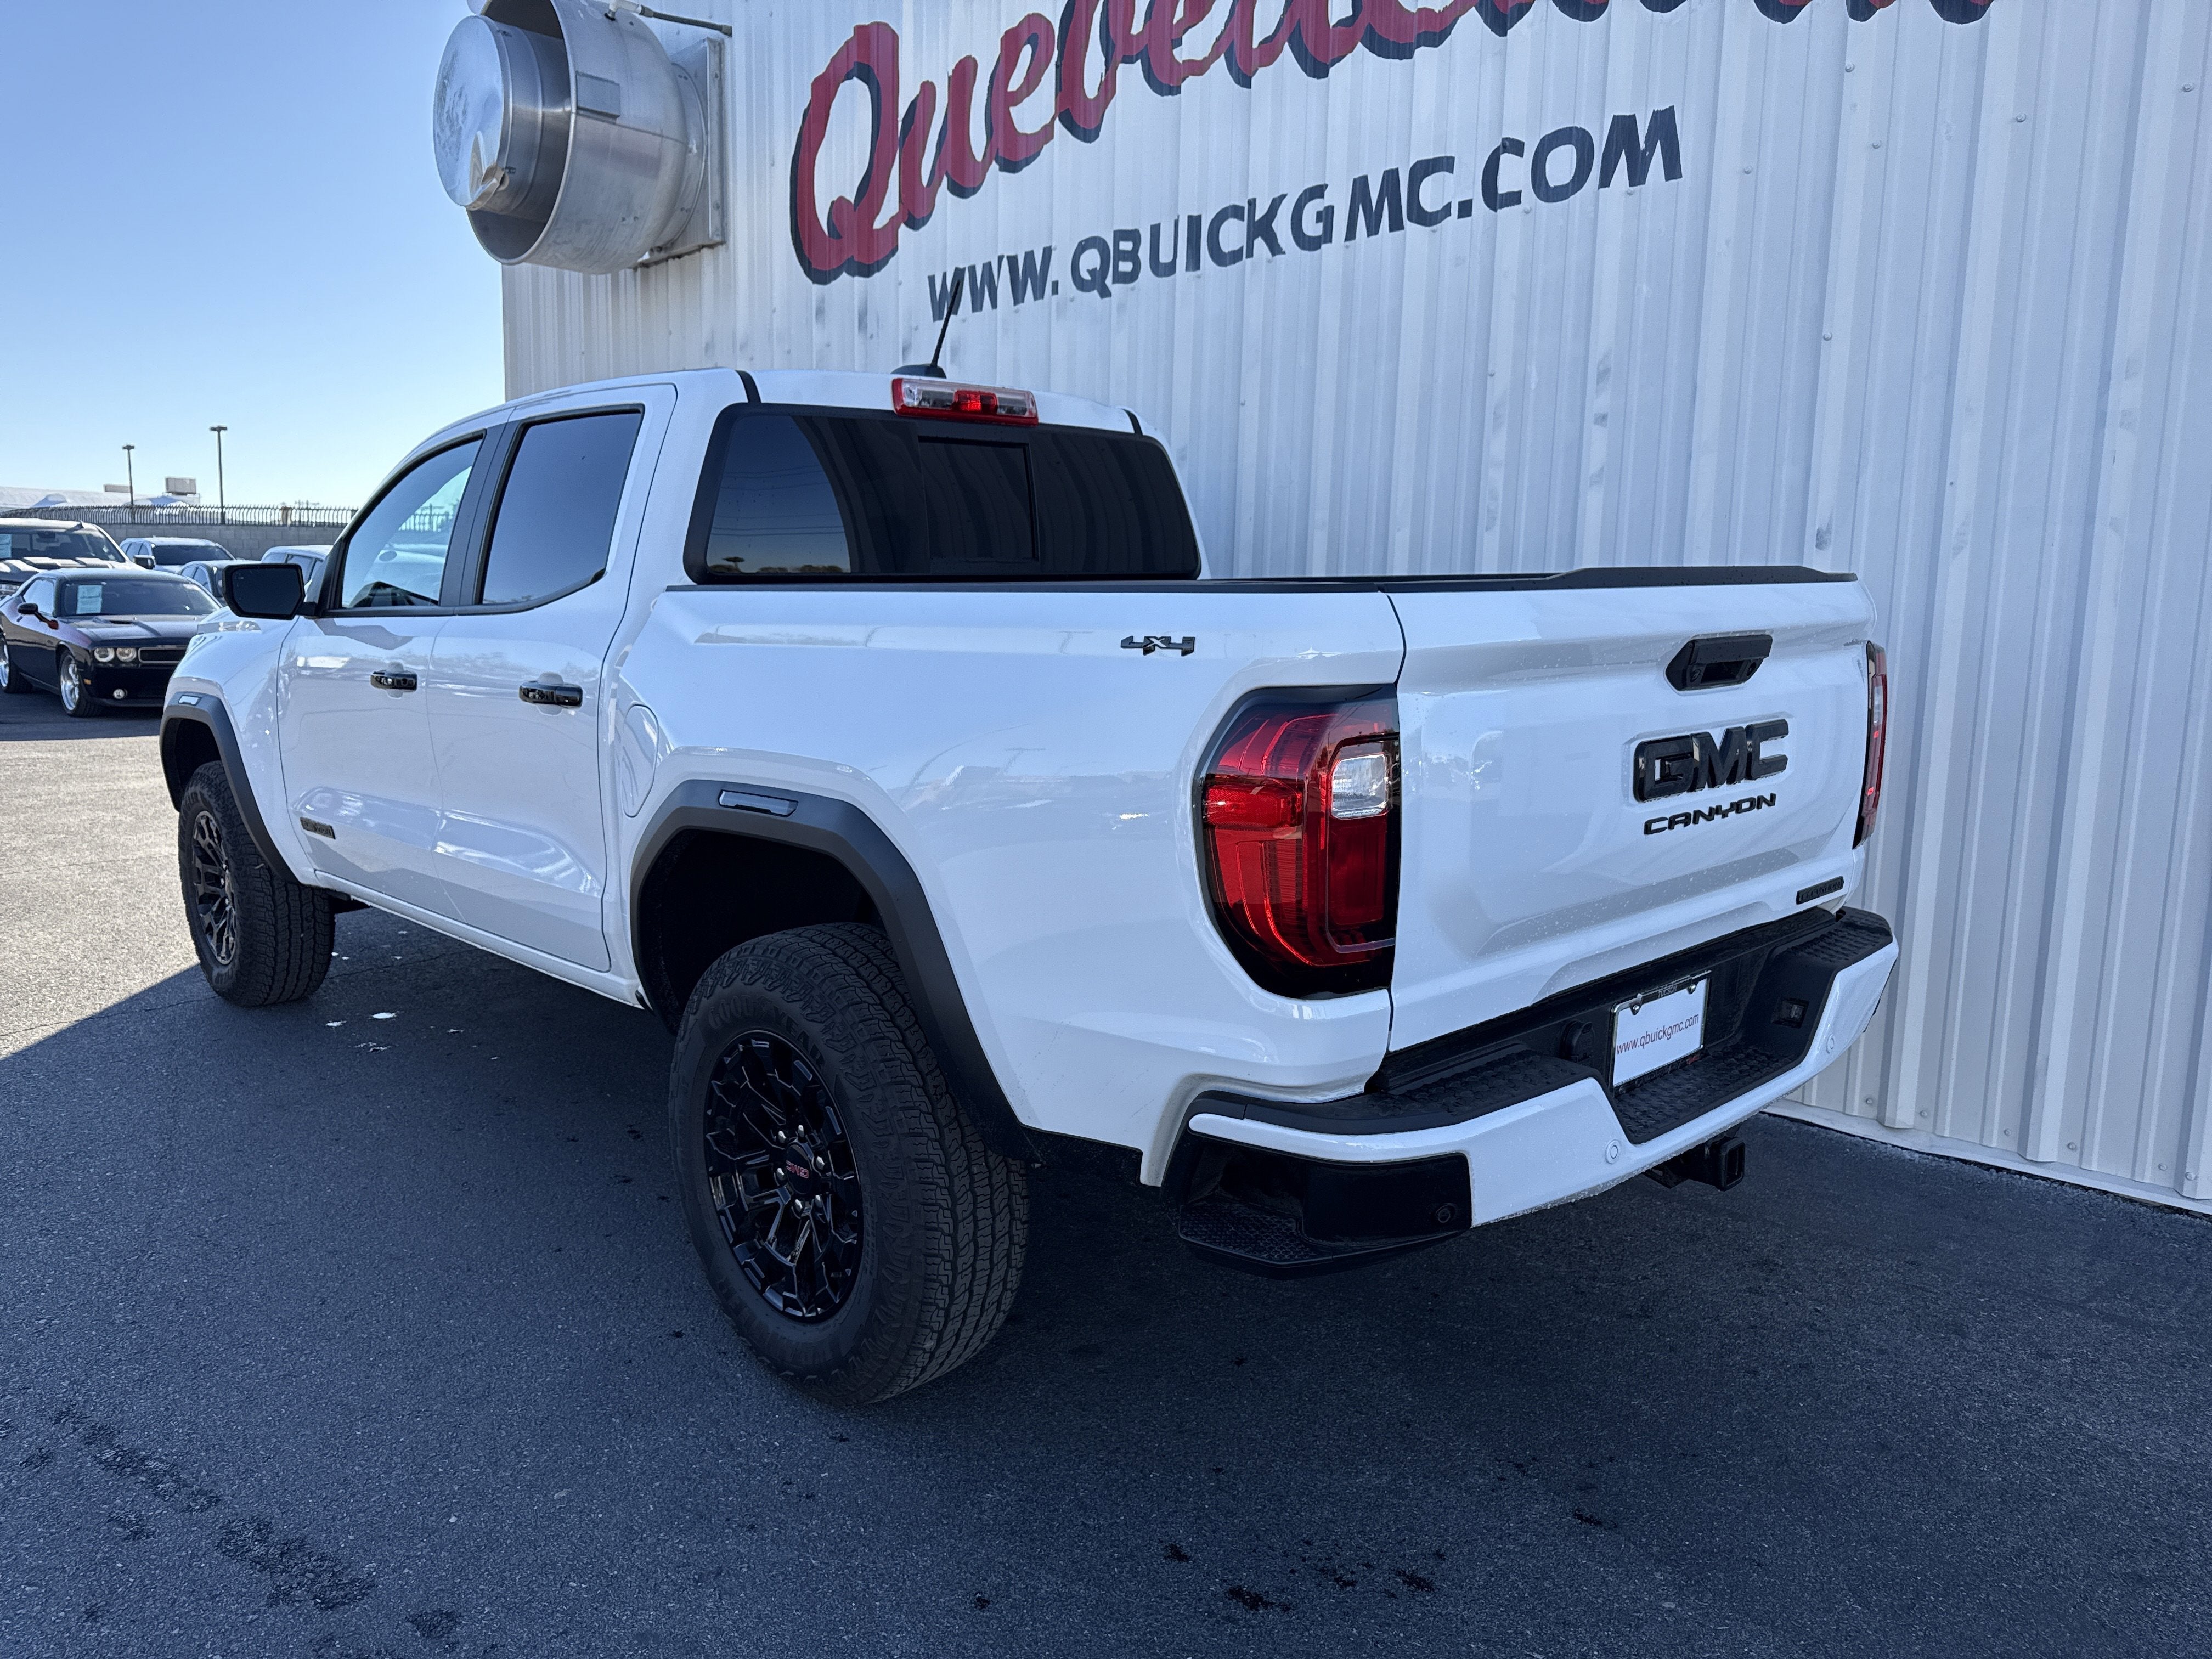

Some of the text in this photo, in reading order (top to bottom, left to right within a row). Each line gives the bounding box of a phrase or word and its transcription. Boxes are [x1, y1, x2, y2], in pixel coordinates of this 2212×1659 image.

[1633, 719, 1789, 803] GMC
[1643, 793, 1776, 835] CANYON
[1658, 985, 1677, 998] TUCSON
[1616, 1013, 1700, 1054] www.qbuickgmc.com
[786, 1160, 809, 1179] GMC
